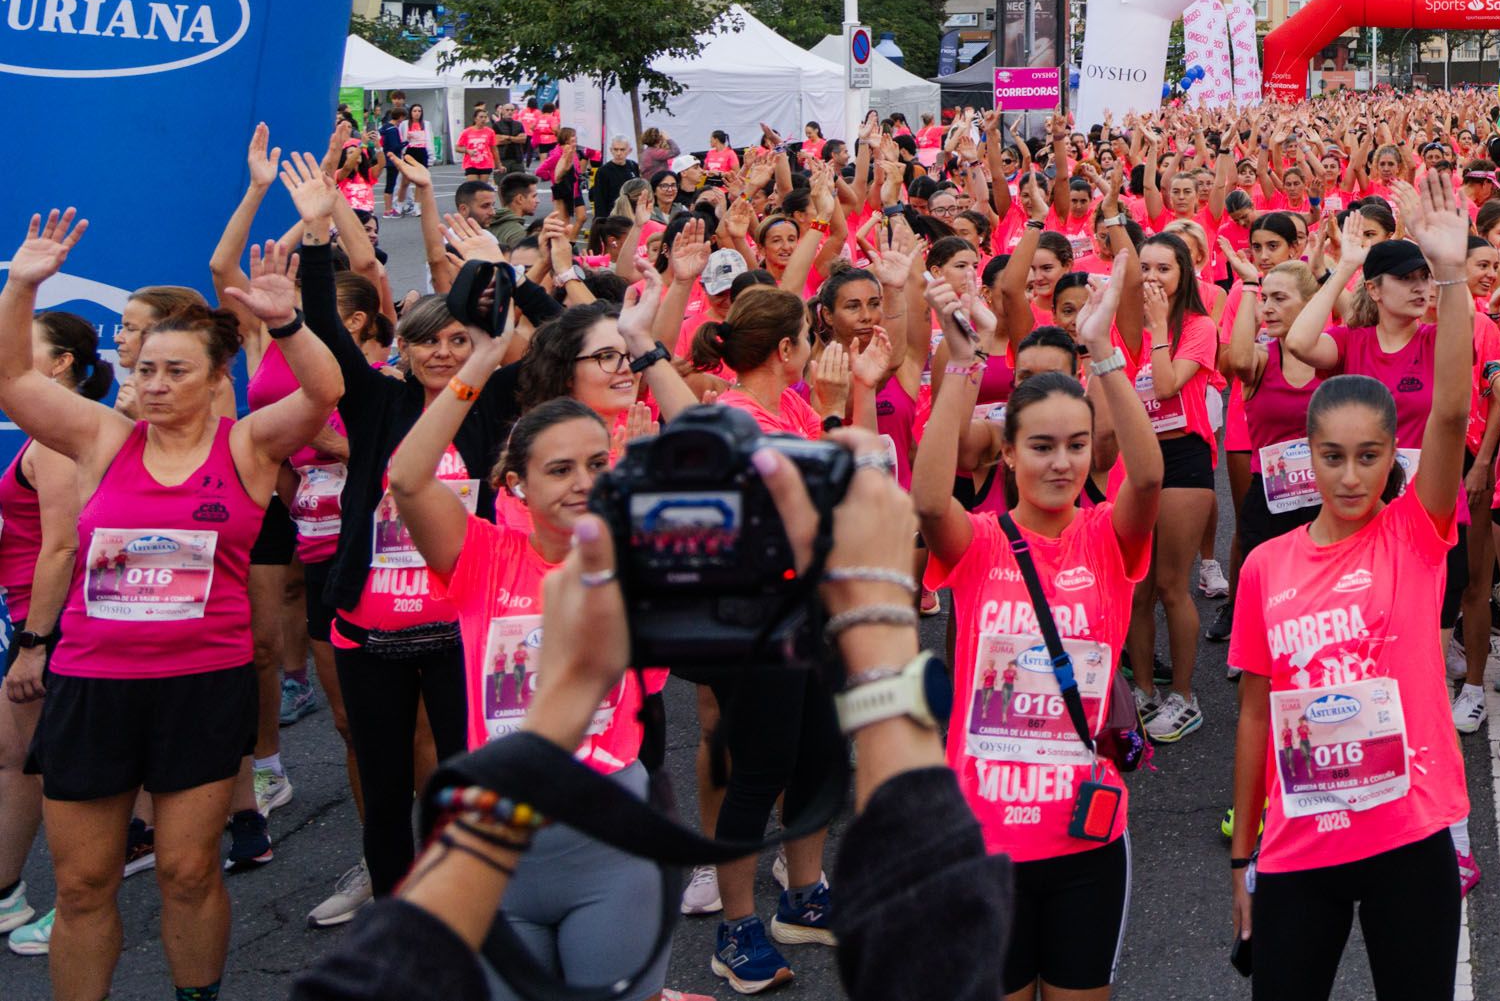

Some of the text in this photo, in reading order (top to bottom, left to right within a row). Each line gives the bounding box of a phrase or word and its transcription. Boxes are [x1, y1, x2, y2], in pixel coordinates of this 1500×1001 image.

[1006, 2, 1043, 11] NEGA
[1086, 64, 1147, 83] OYSHO
[996, 86, 1059, 98] CORREDORAS
[1288, 470, 1316, 483] 016
[379, 554, 413, 564] YSHO
[126, 568, 173, 585] 016
[394, 598, 423, 613] 2026
[990, 645, 1014, 655] SUMA
[494, 708, 526, 717] CARRERA
[1013, 694, 1065, 717] 016
[1309, 704, 1358, 719] ASTURIANA
[979, 726, 1009, 736] CARRERA
[1010, 728, 1019, 737] DE
[1020, 729, 1030, 737] LA
[1030, 729, 1052, 738] MUJER
[979, 741, 1021, 754] OYSHO
[1314, 741, 1364, 767] 016
[977, 763, 1075, 803] MUJER
[1293, 782, 1317, 792] CARRERA
[1318, 781, 1326, 790] DE
[1327, 780, 1336, 789] LA
[1336, 778, 1359, 788] MUJER
[1370, 770, 1396, 783] CORUÑA
[1298, 794, 1336, 808] OYSHO
[1358, 785, 1396, 803] Santander
[1004, 805, 1041, 825] 2026
[1315, 811, 1352, 834] 2026
